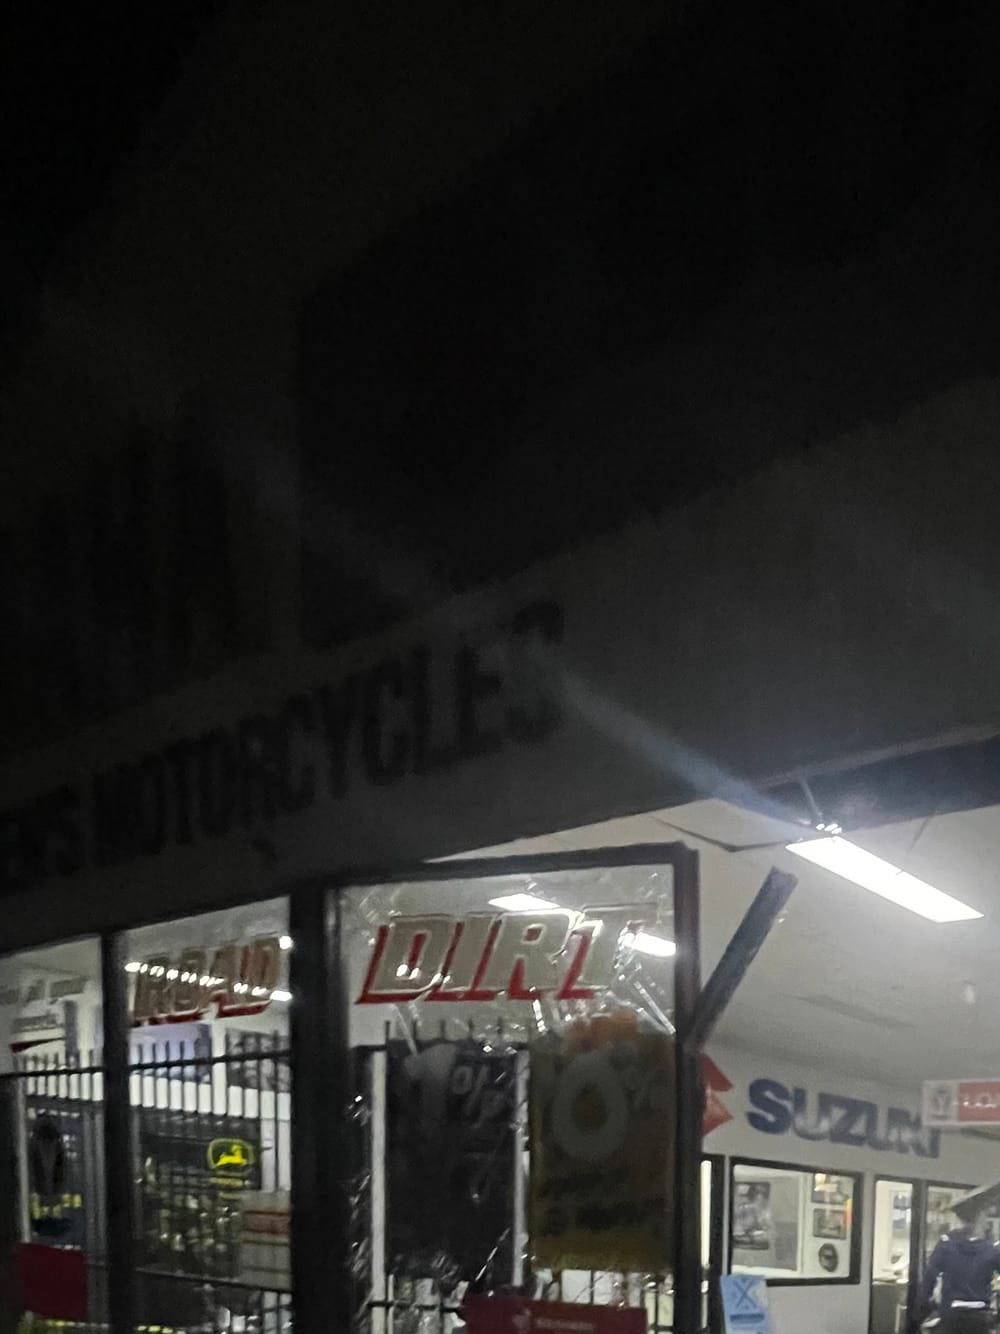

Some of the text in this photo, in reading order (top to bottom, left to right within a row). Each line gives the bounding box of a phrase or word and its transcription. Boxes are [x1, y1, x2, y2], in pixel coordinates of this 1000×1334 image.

[96, 600, 566, 870] MOTORCYCLES
[131, 935, 280, 1027] ROAD
[354, 903, 660, 1005] DIRT
[746, 1078, 941, 1160] SUZUKI
